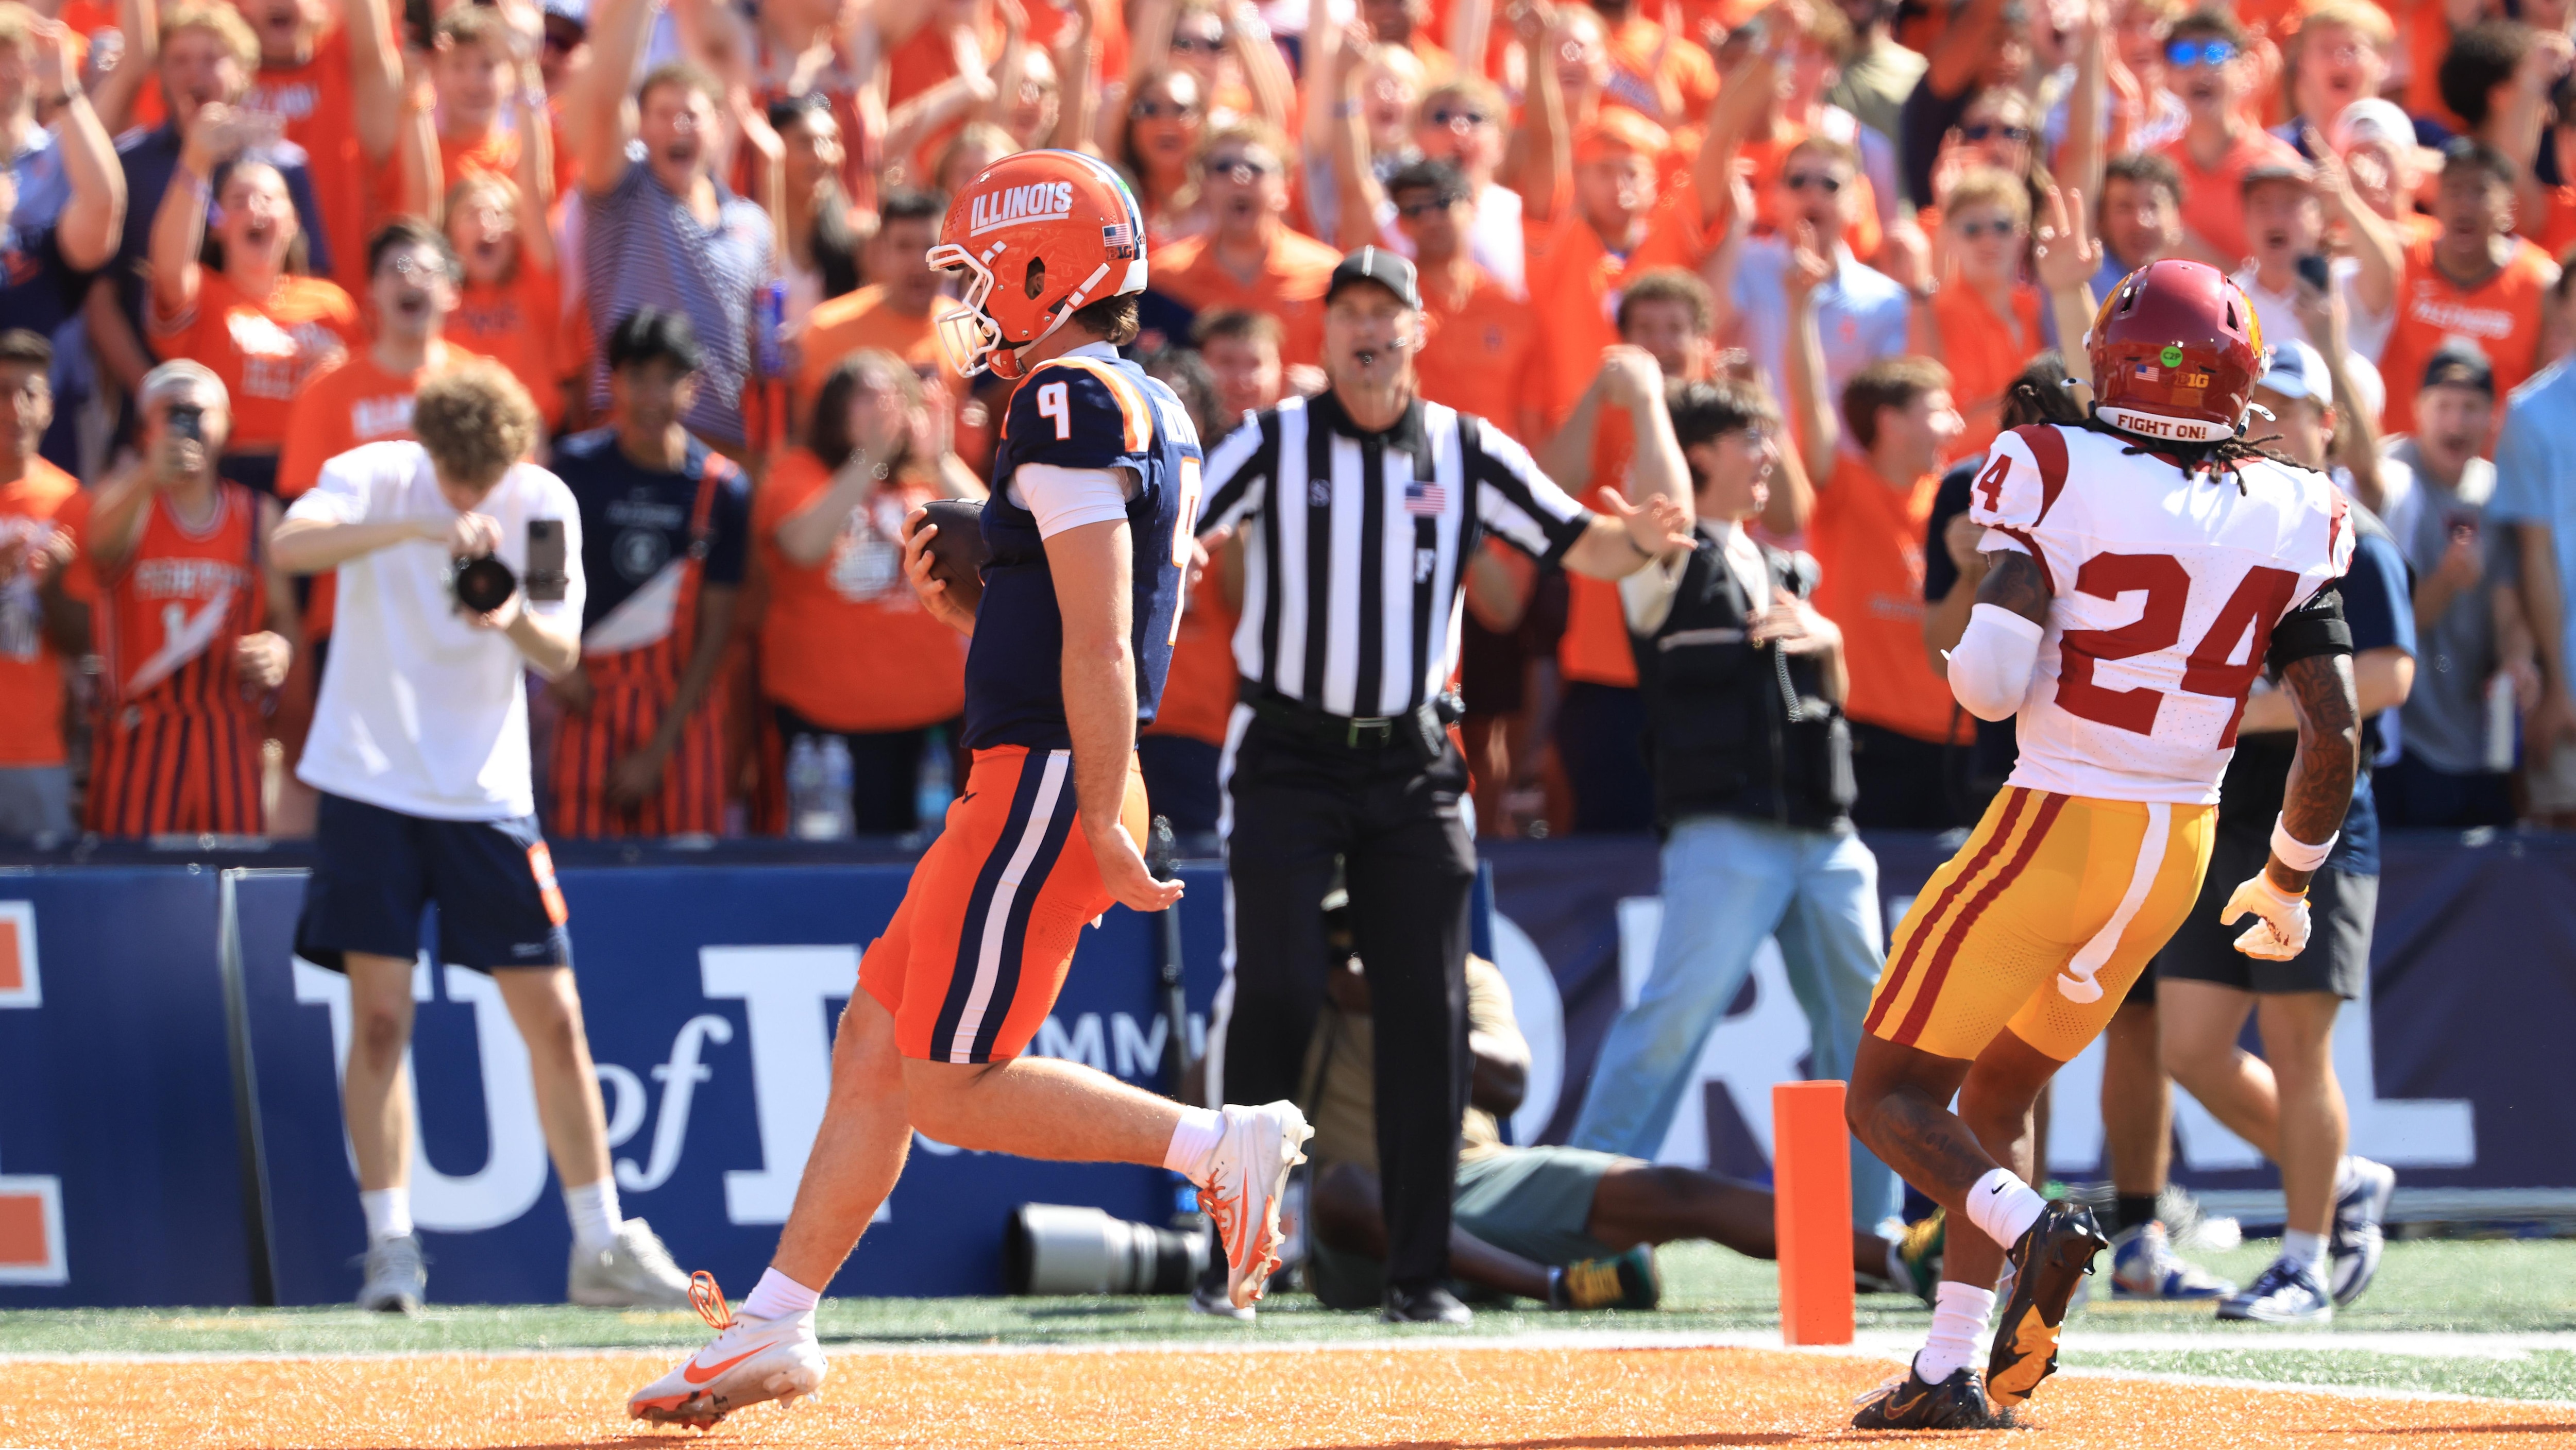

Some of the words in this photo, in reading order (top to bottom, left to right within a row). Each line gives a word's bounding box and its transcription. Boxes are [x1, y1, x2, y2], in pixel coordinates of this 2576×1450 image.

[970, 182, 1073, 230] ILLINOIS
[2163, 351, 2181, 360] C2P
[1037, 380, 1071, 441] 9
[2117, 414, 2166, 436] FIGHT
[2176, 425, 2207, 440] ON!
[1968, 453, 2012, 513] 4
[1167, 457, 1202, 647] 9
[1416, 547, 1436, 584] F
[2054, 551, 2300, 751] 24
